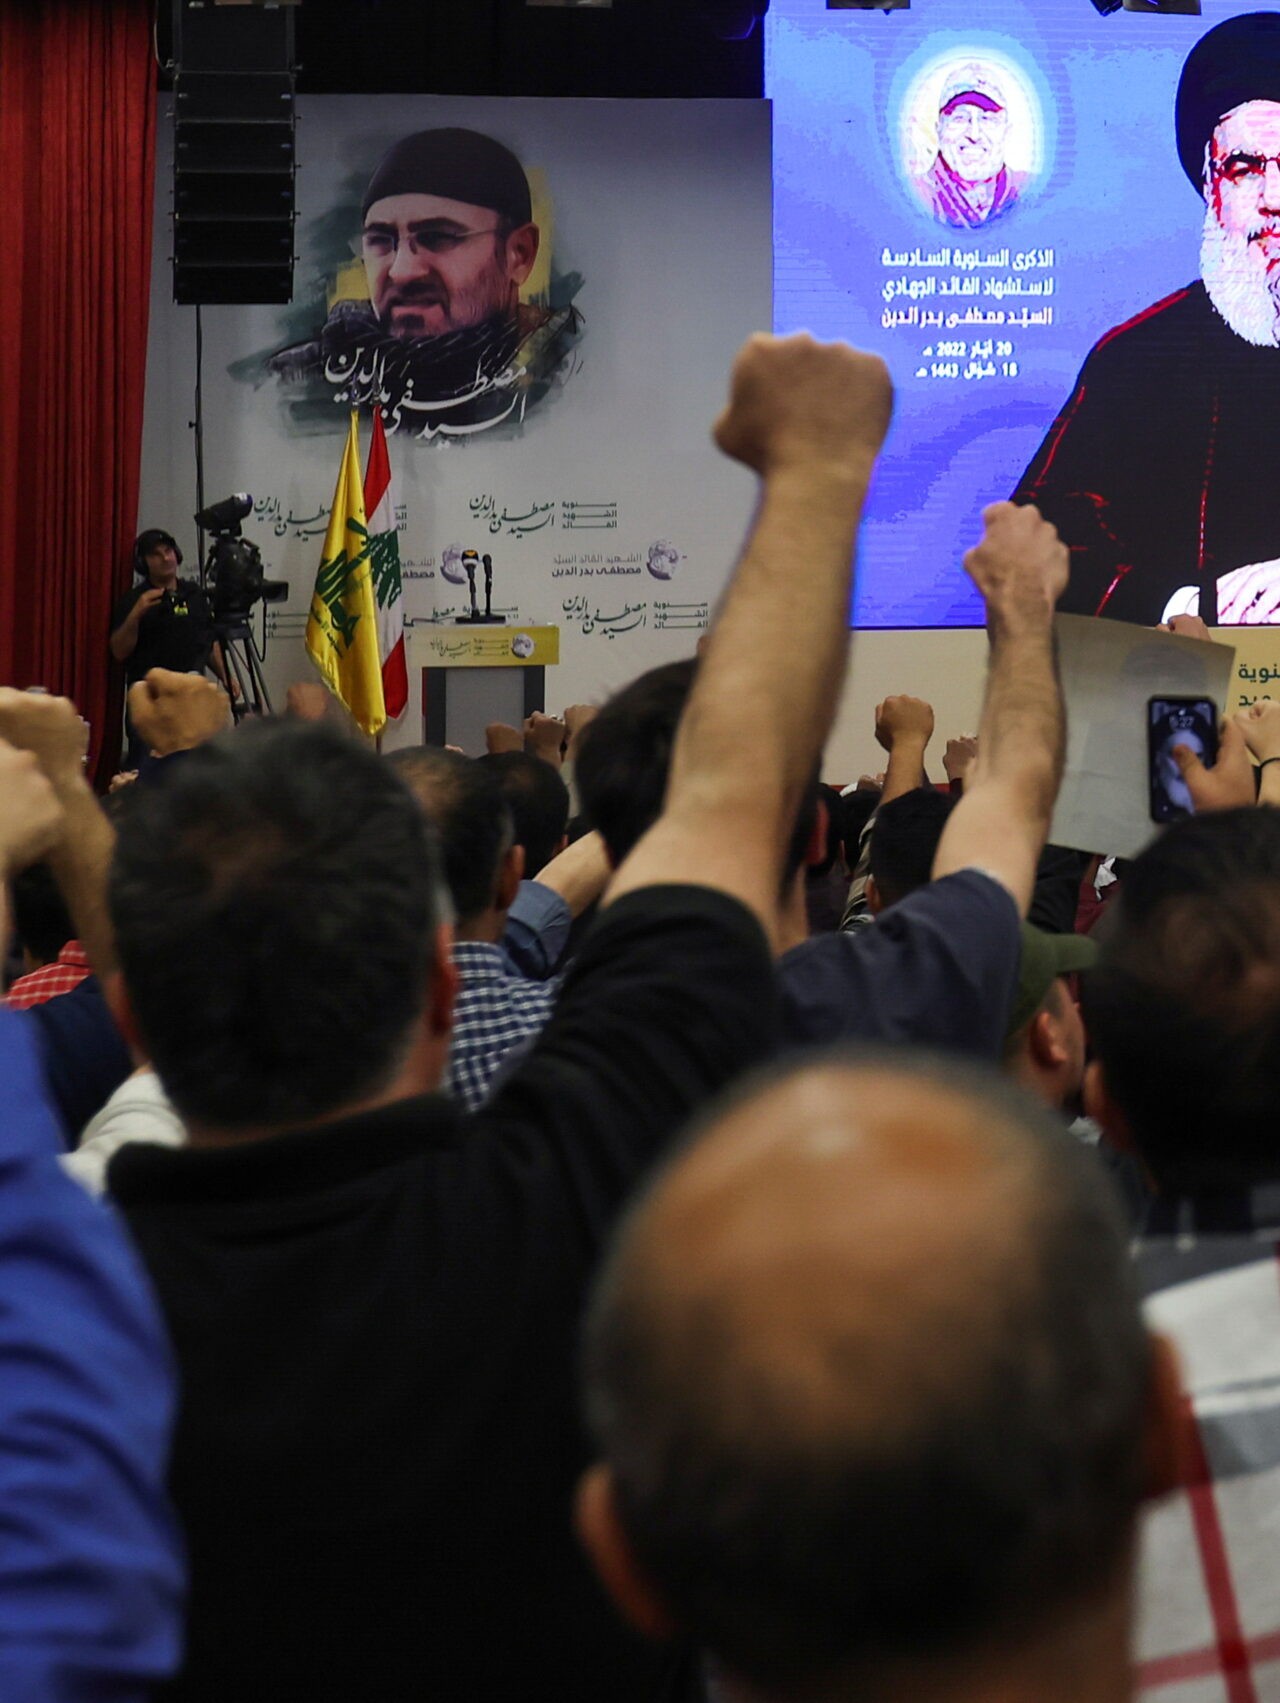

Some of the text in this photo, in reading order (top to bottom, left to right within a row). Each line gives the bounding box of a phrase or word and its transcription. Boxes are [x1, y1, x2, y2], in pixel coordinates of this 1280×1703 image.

[881, 248, 950, 267] السادسة
[1012, 249, 1054, 271] الذكرى
[983, 276, 1054, 300] لاستشهاد
[881, 306, 918, 328] الدين
[919, 309, 944, 328] بدر
[945, 306, 1004, 328] مصطفى
[936, 341, 966, 357] 2022
